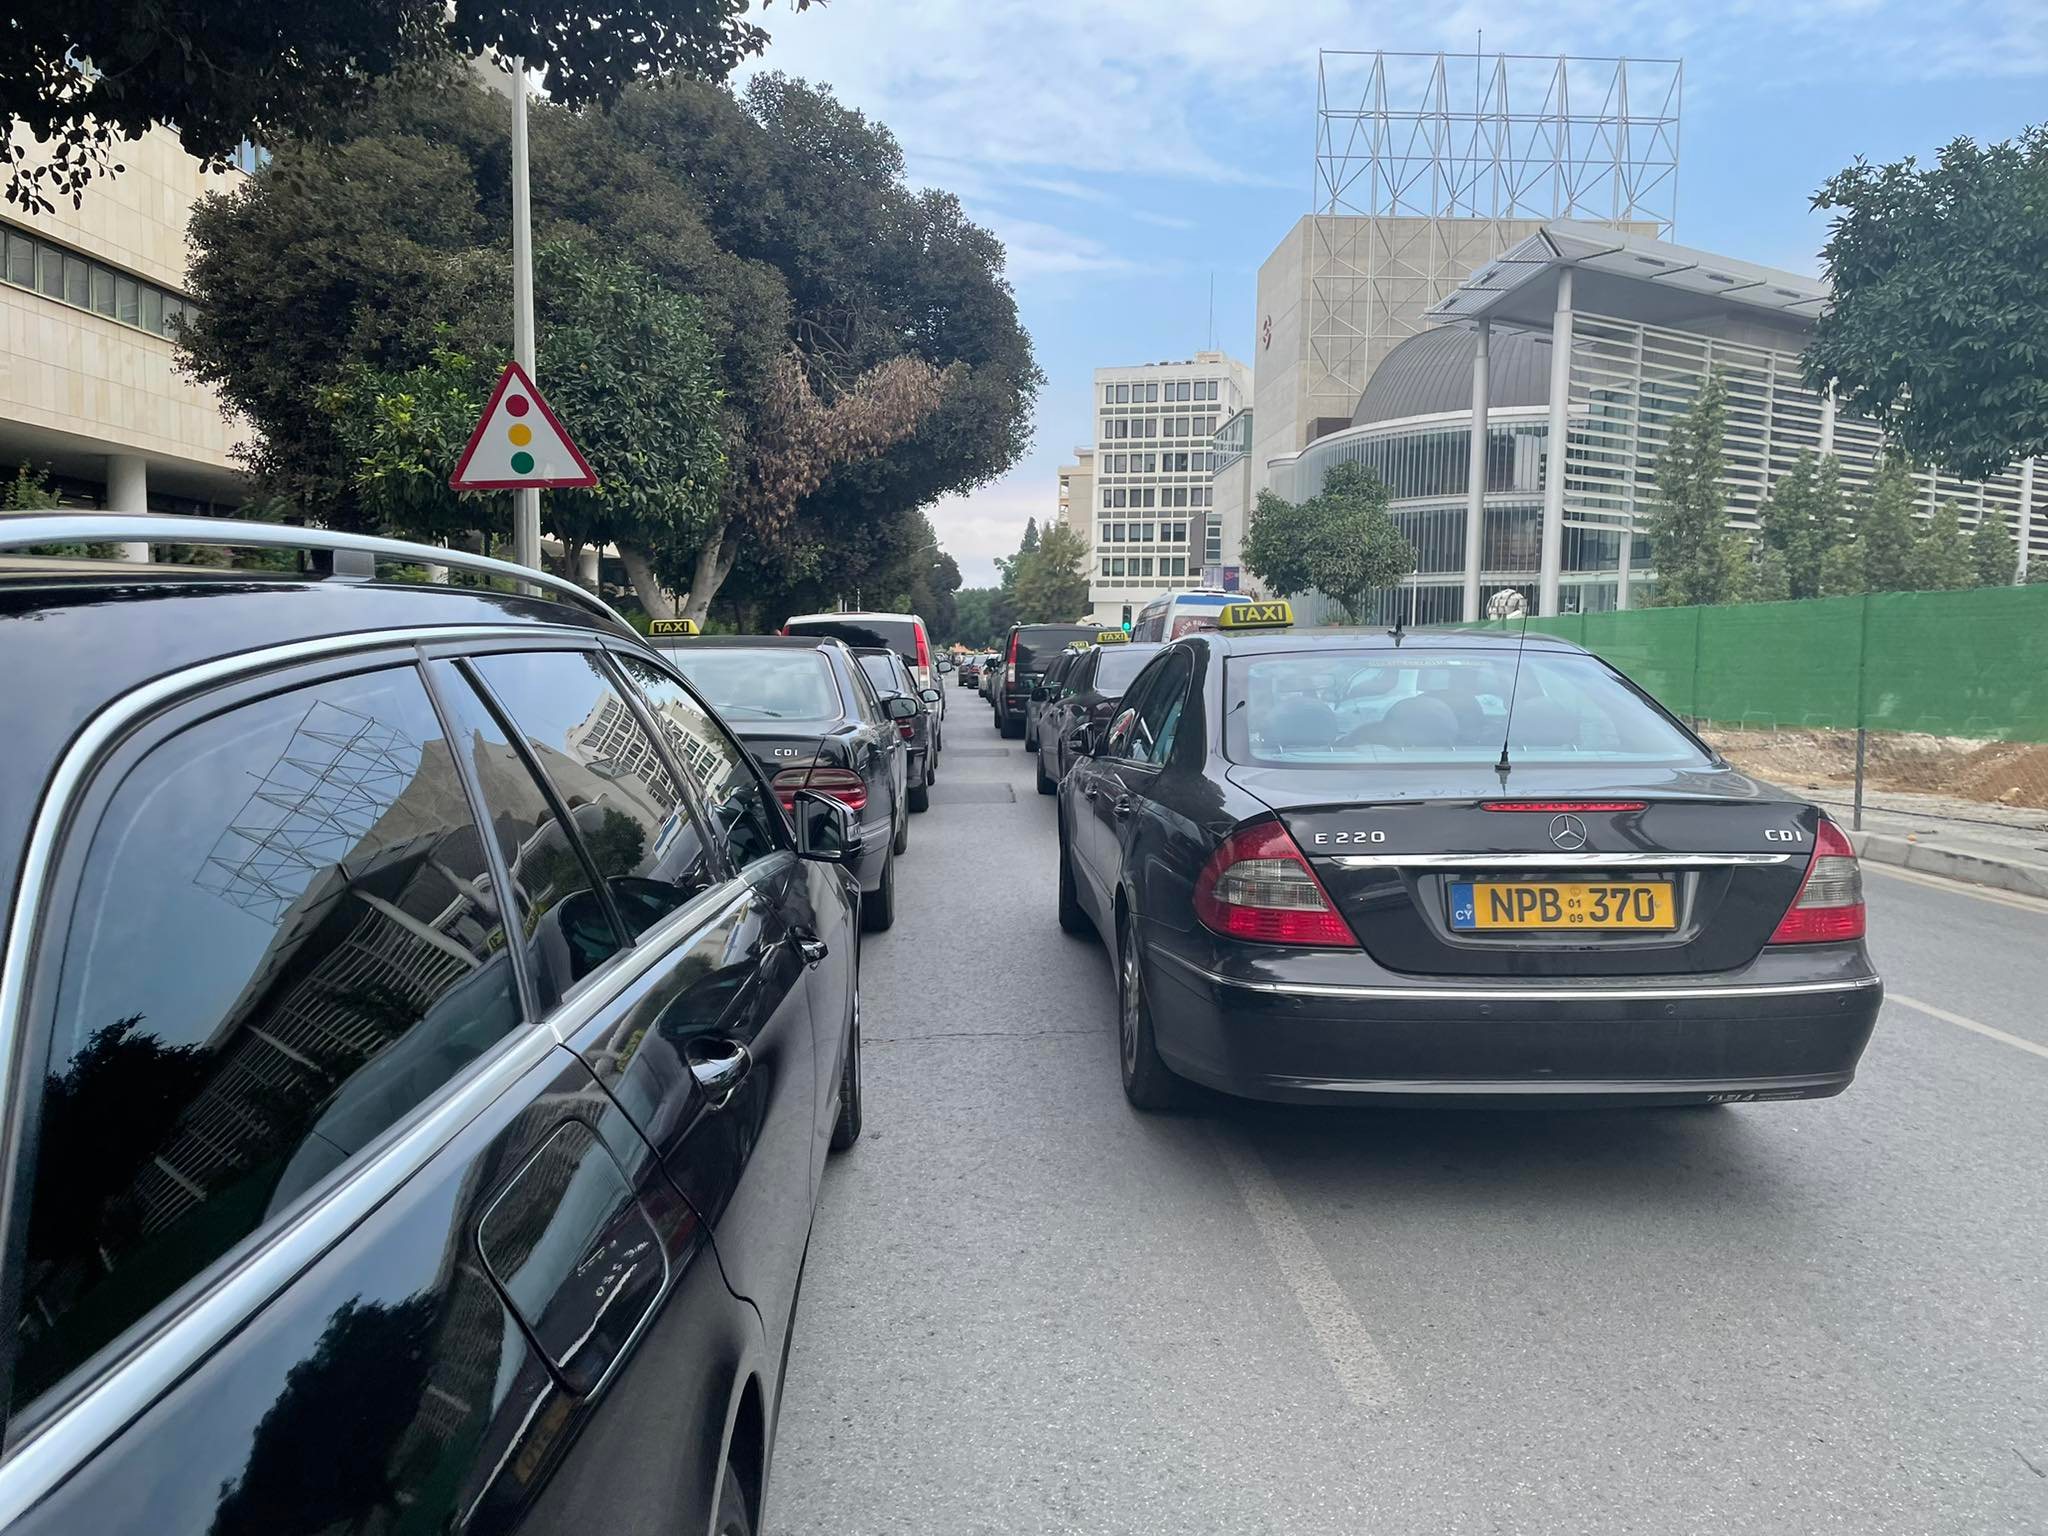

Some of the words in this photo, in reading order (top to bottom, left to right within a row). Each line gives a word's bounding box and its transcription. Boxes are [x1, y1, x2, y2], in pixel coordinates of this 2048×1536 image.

[1234, 605, 1284, 622] TAXI
[655, 622, 688, 633] TAXI
[1102, 633, 1124, 641] TAXI
[774, 748, 798, 756] CDI
[1315, 832, 1329, 844] E
[1335, 831, 1386, 844] 220
[1764, 829, 1803, 842] CDI
[1490, 888, 1562, 923] NPB
[1588, 888, 1655, 923] 370
[1568, 898, 1581, 908] 01
[1455, 910, 1473, 920] CY
[1570, 913, 1584, 923] 09
